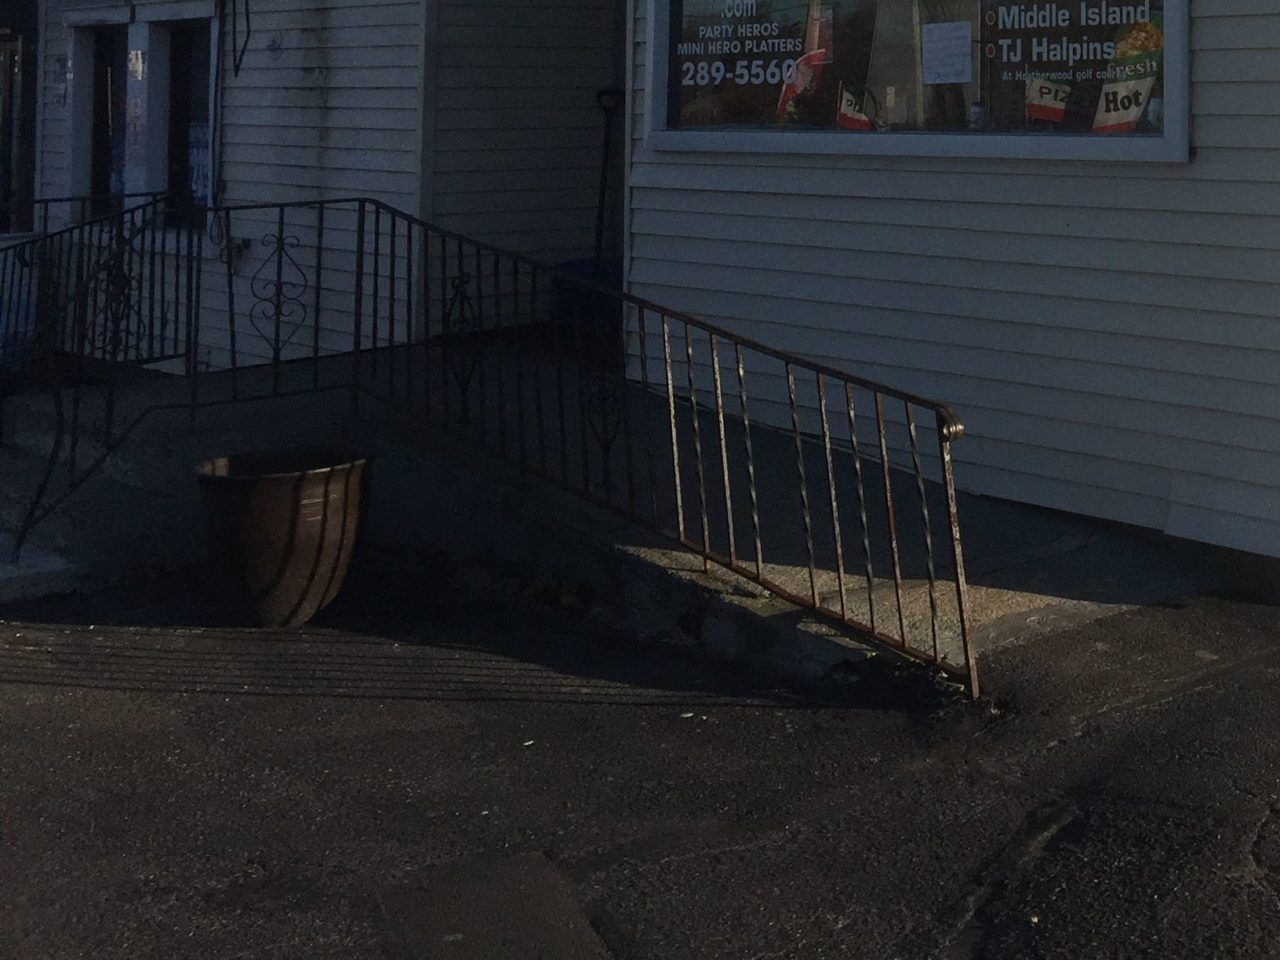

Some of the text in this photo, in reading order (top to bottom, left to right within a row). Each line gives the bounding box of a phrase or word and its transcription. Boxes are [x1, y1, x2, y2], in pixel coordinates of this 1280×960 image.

[998, 0, 1150, 30] Middle Island
[699, 22, 779, 38] PARTY HEROS
[677, 38, 802, 56] MINI HERO PLATTERS
[998, 39, 1022, 62] TJ
[1031, 37, 1116, 66] Halpins
[681, 59, 798, 86] 289-5560
[1104, 89, 1142, 113] Hot
